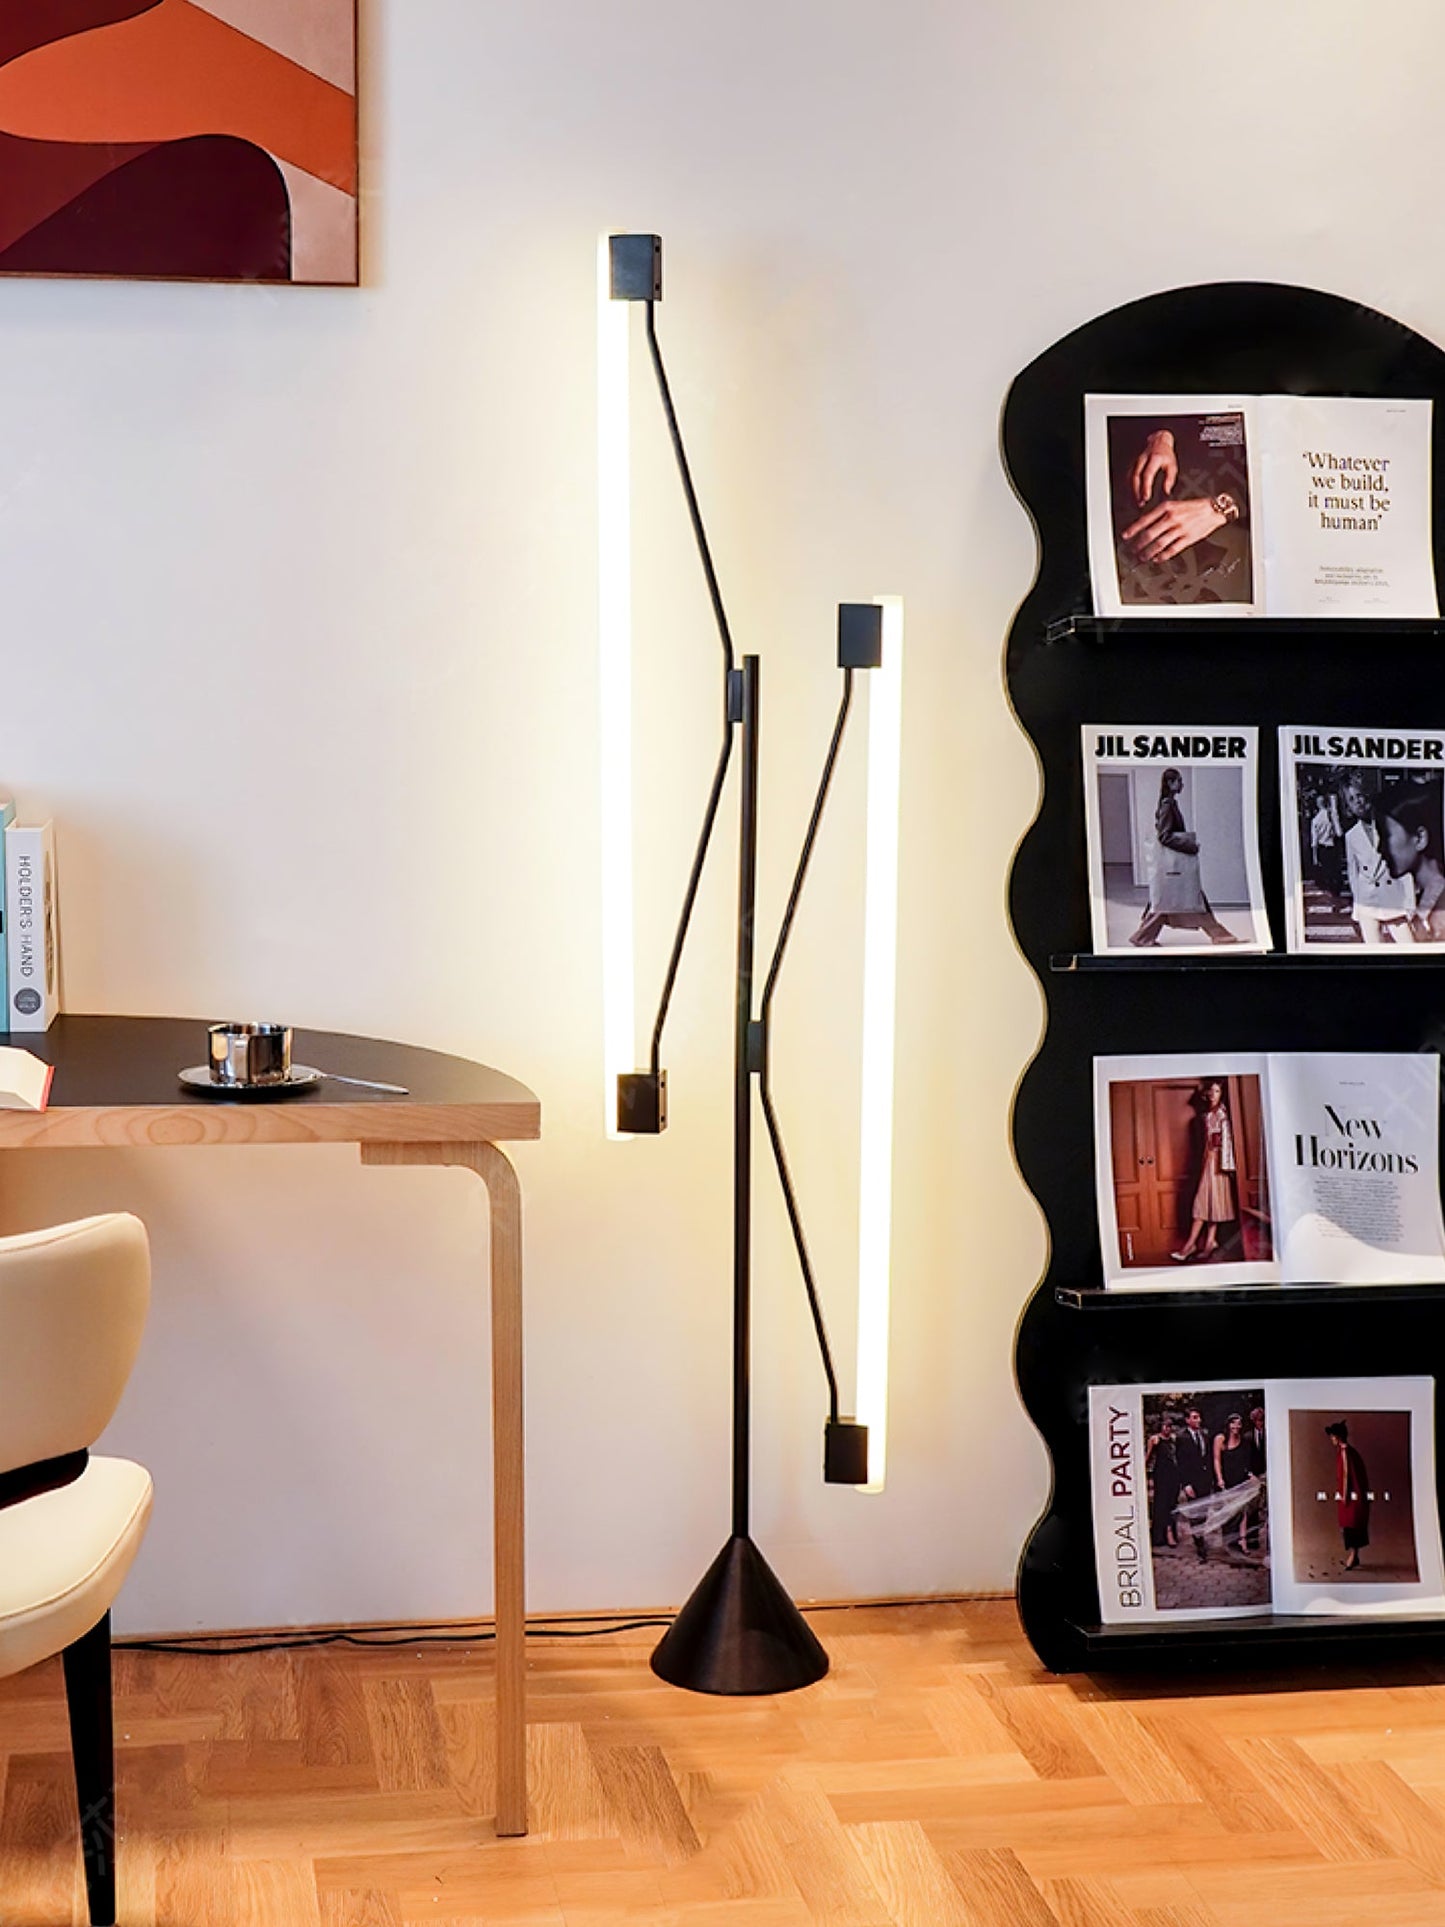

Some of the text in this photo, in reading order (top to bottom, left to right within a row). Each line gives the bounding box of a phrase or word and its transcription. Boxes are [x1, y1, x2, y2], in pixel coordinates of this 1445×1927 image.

[1311, 474, 1389, 493] we build,
[1308, 492, 1391, 512] it must be
[19, 934, 35, 979] HAND
[1323, 1104, 1387, 1138] New
[1295, 1133, 1419, 1174] Horizons
[1108, 1406, 1143, 1608] BRIDAL PARTY
[1316, 1490, 1391, 1502] MARNI
